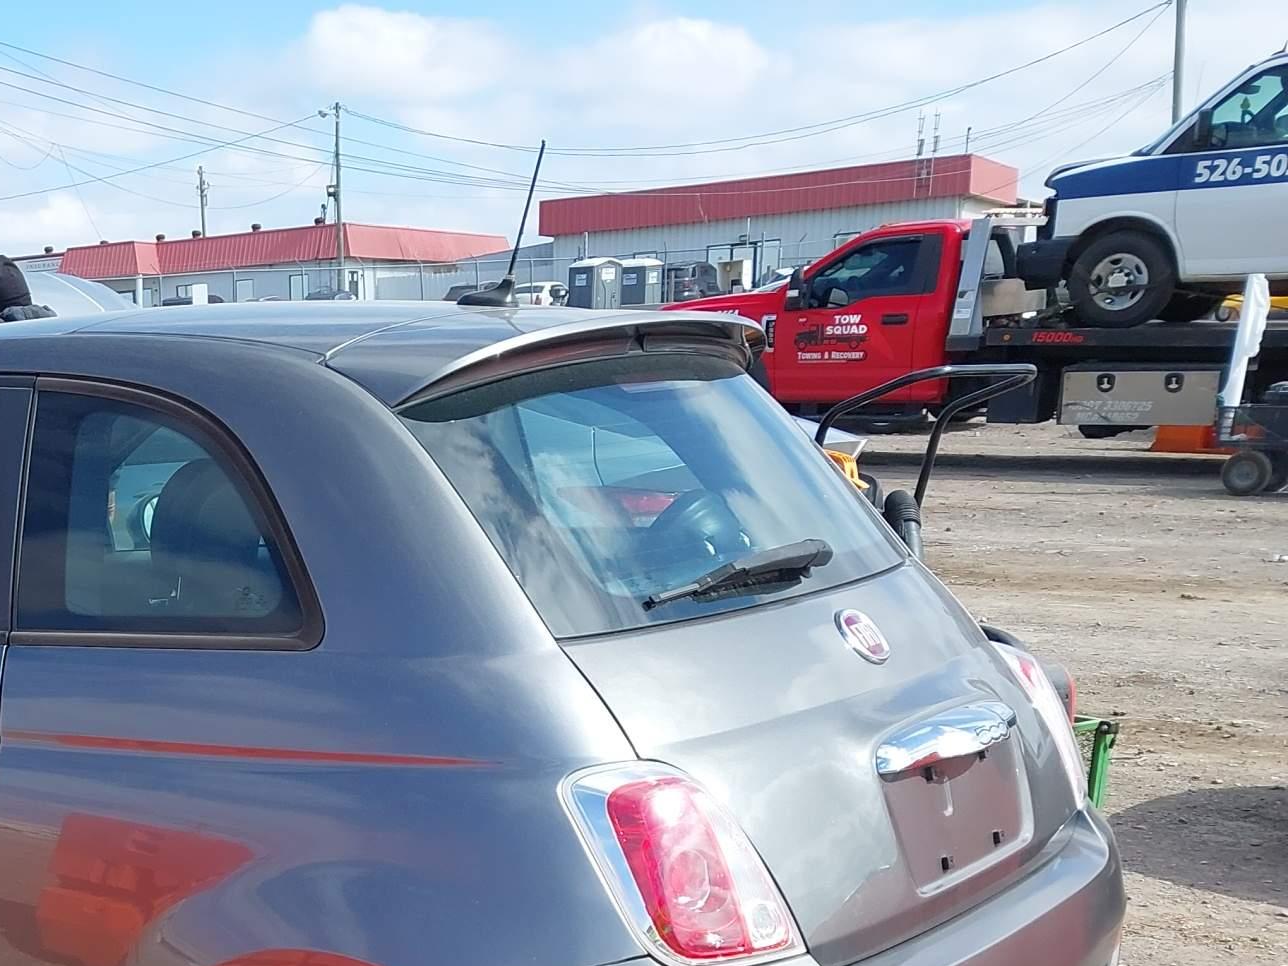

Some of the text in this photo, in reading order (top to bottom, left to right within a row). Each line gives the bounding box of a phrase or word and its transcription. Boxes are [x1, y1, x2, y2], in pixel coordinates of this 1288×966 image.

[1194, 153, 1288, 183] 526-50
[833, 314, 862, 325] TOW
[824, 324, 869, 335] SQUAD
[831, 351, 865, 360] RECOVERY
